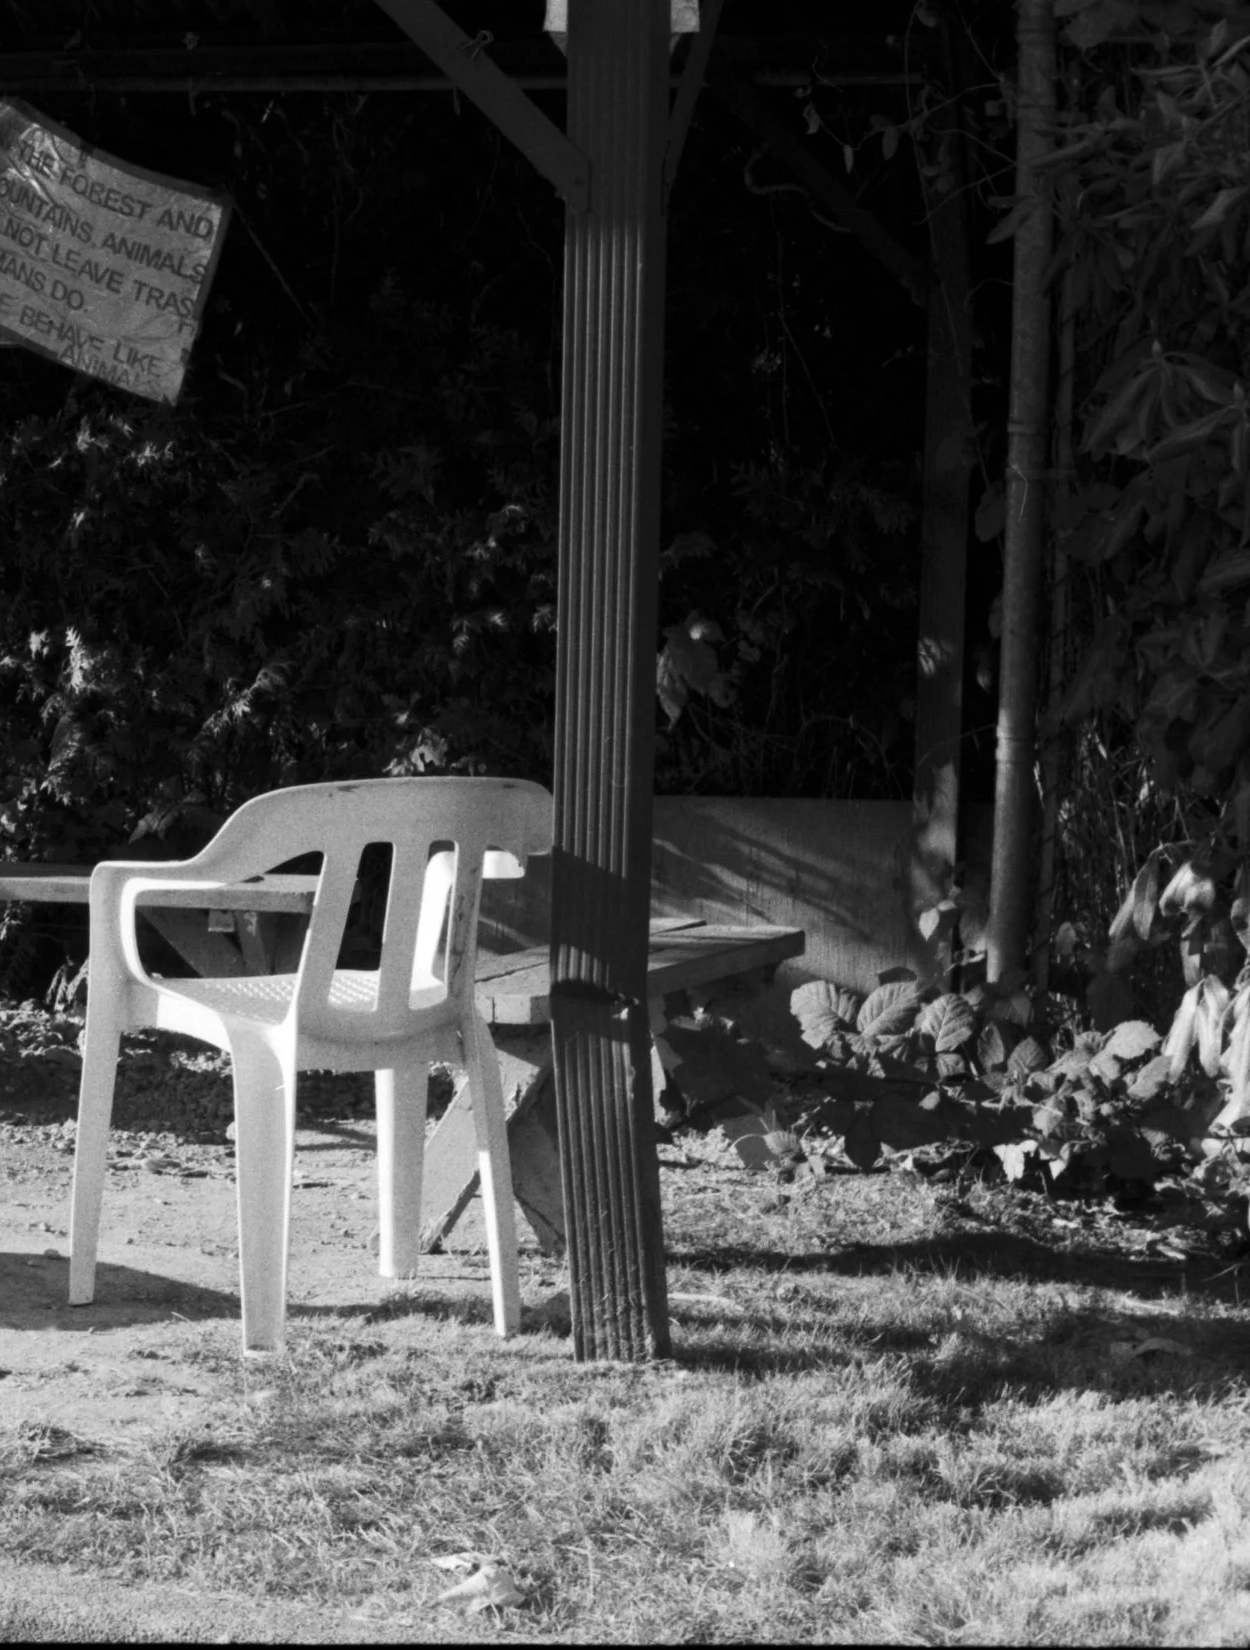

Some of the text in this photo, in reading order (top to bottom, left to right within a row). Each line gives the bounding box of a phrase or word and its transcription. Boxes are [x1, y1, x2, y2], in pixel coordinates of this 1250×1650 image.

[19, 139, 215, 239] THE FOREST AND
[2, 216, 50, 256] NOT
[52, 242, 125, 295] LEAVE
[102, 232, 207, 285] ANIMALS
[51, 280, 89, 312] DO.
[19, 305, 105, 352] BEHAVE
[113, 338, 161, 379] LIKE
